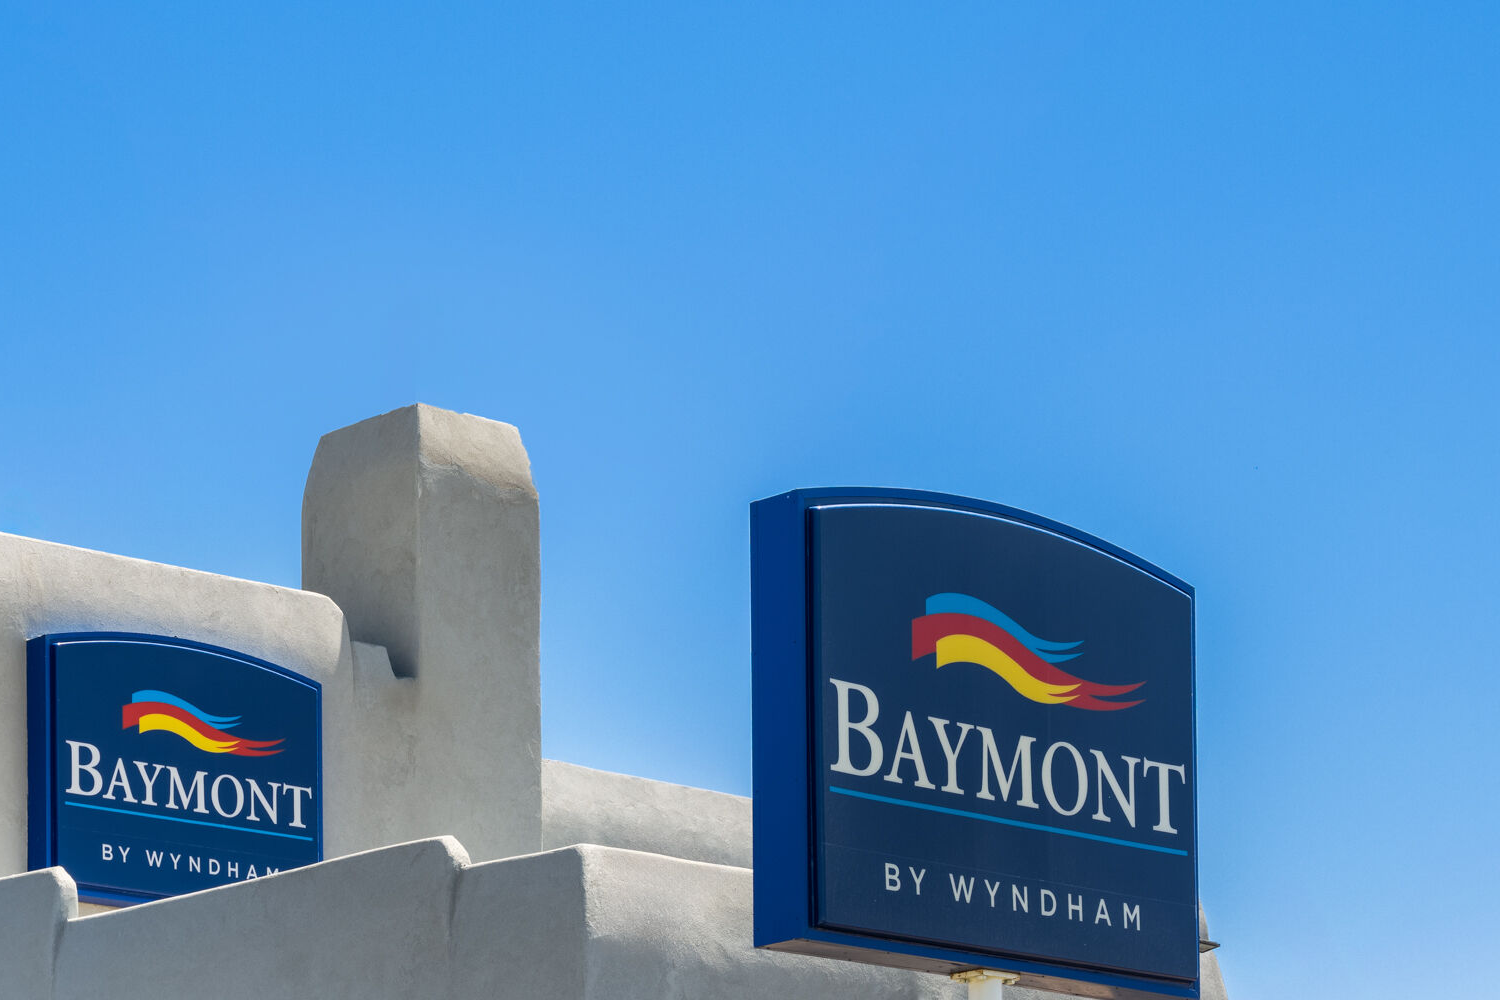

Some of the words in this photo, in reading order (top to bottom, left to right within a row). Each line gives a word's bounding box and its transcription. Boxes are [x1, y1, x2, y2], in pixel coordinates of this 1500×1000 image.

[65, 740, 312, 828] BAYMONT
[829, 677, 1185, 834] BAYMONT
[102, 844, 131, 863] BY
[884, 862, 926, 895] BY
[949, 873, 1142, 931] WYNDHAM
